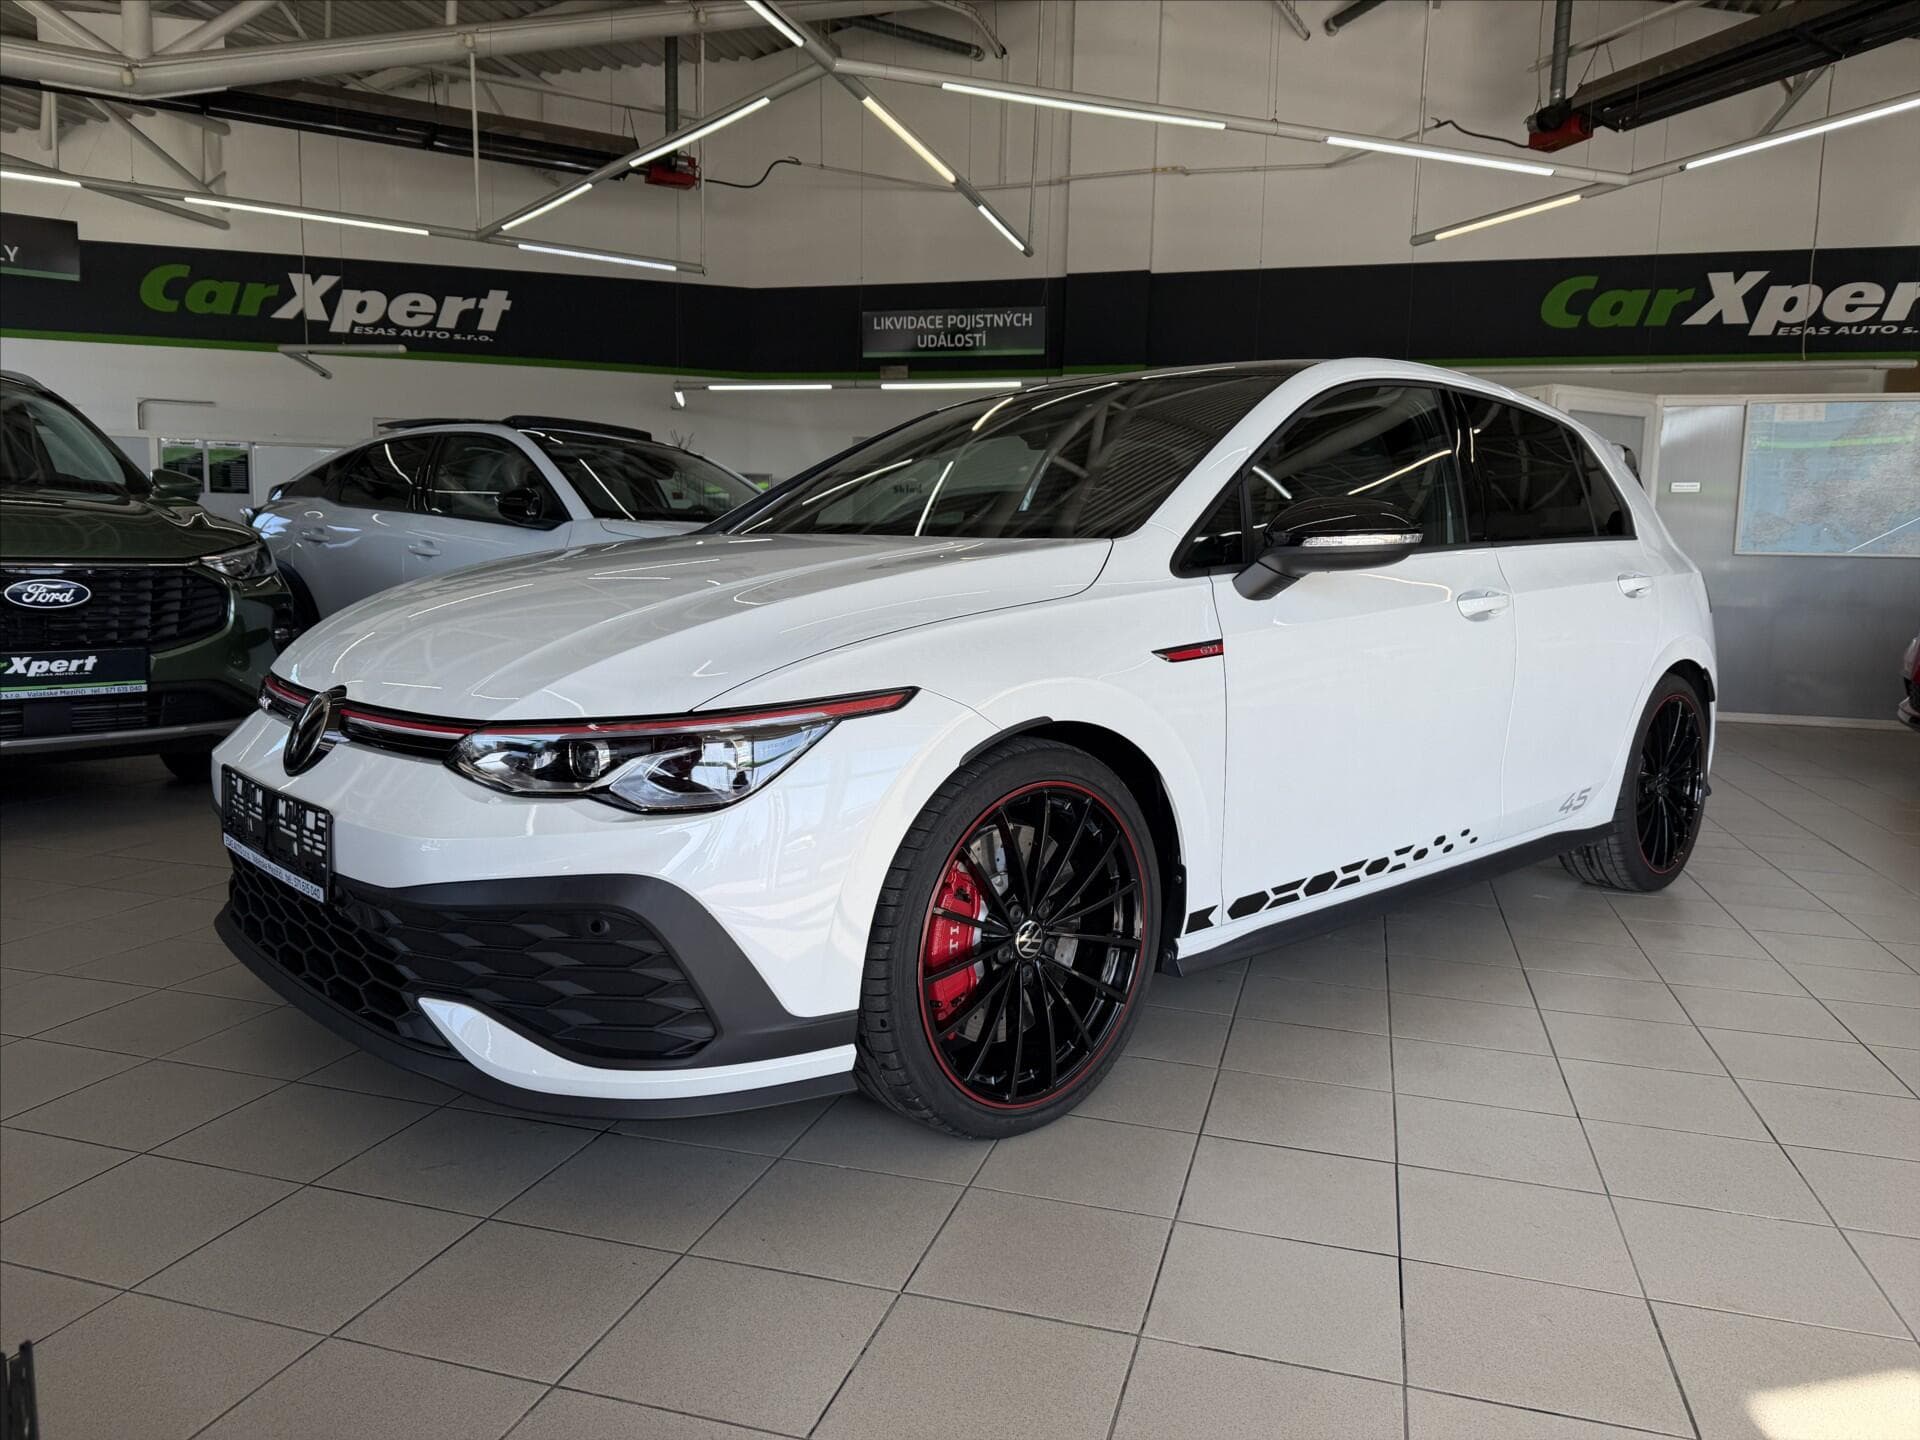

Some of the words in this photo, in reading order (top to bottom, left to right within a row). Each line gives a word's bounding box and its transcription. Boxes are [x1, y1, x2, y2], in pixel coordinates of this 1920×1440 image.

[0, 244, 19, 262] Y
[140, 264, 512, 333] CarXpert
[1541, 271, 1920, 335] CarXper
[873, 315, 943, 330] LIKVIDACE
[947, 311, 1033, 330] POJISTNÝCH
[353, 326, 397, 336] ESAS
[400, 329, 450, 339] AUTO
[453, 333, 494, 342] s.r.o.
[917, 330, 986, 348] UDÁLOSTÍ
[1777, 326, 1831, 336] ESAS
[1834, 325, 1899, 335] AUTO
[22, 583, 75, 603] Ford
[0, 655, 98, 677] Xpert
[1559, 787, 1591, 813] 45
